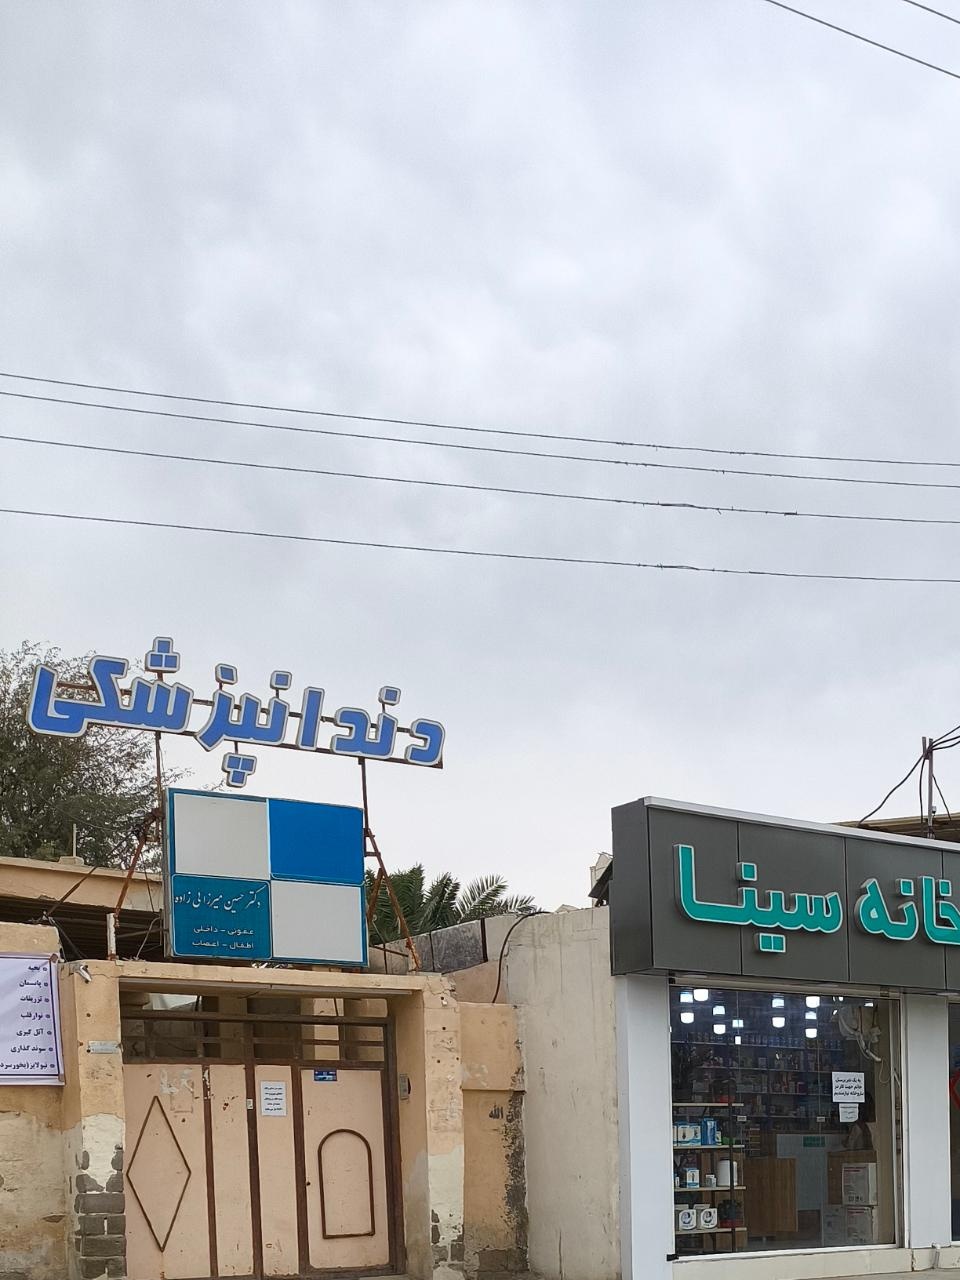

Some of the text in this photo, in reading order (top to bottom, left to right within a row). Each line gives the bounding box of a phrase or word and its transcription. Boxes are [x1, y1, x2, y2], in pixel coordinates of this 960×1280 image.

[27, 636, 446, 787] دندانپزشکی
[224, 894, 244, 913] حسین
[245, 885, 267, 909] دکتر
[673, 843, 844, 954] سینا
[193, 925, 219, 933] داخلی
[229, 942, 254, 950] اطفال
